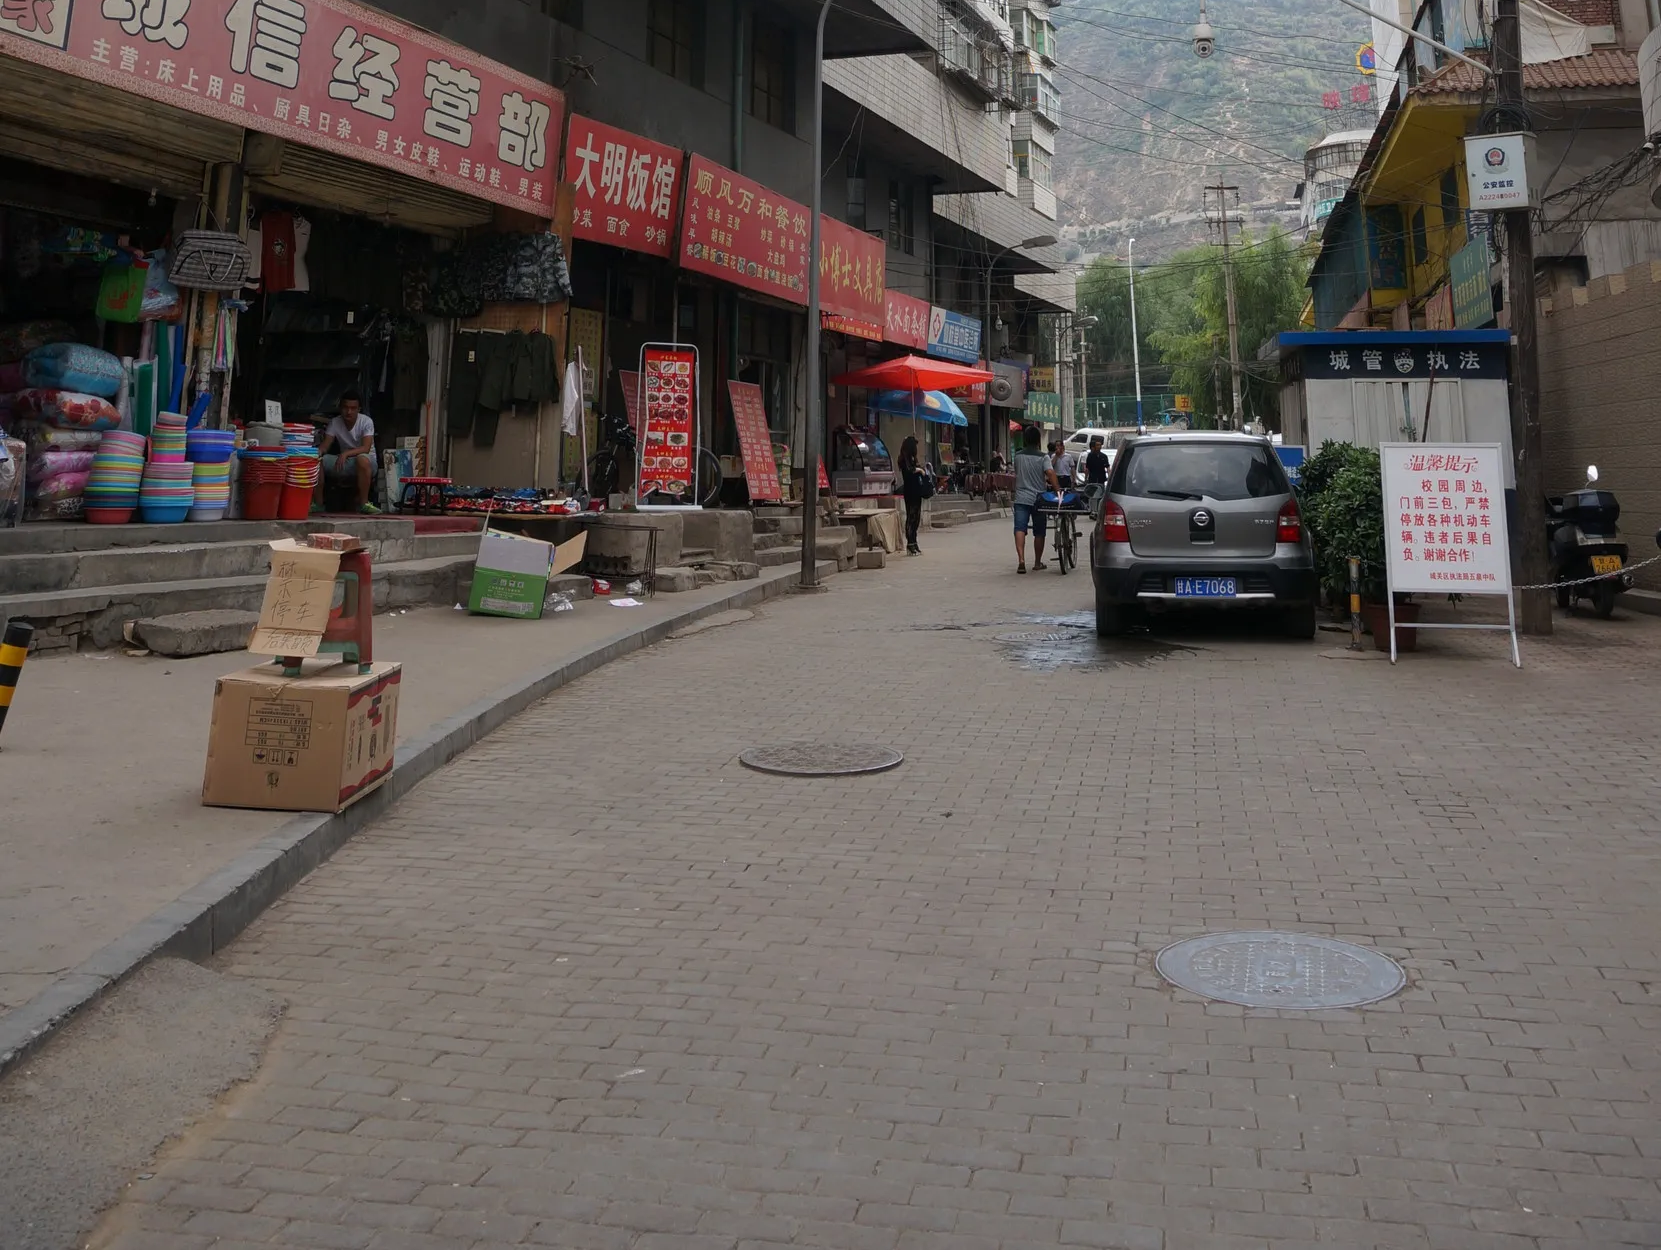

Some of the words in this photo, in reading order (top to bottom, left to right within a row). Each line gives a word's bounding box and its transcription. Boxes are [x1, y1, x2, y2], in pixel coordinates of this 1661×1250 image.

[575, 133, 676, 220] 大明饭馆
[1483, 180, 1515, 189] 公安监控
[694, 168, 807, 237] 顺风万和餐饮
[606, 216, 630, 236] 面食
[645, 226, 667, 246] 砂锅
[819, 241, 883, 305] 小博士文具店
[1329, 350, 1383, 370] 城管
[1427, 350, 1480, 370] 执法
[1408, 454, 1478, 473] 温馨提示
[1421, 480, 1487, 493] 校园周边，
[1399, 496, 1489, 510] 门前三包，严禁
[1400, 513, 1491, 527] 停放各种机动车
[1401, 530, 1491, 545] 辆。违者后果自
[1403, 547, 1475, 562] 负。谢谢合作！
